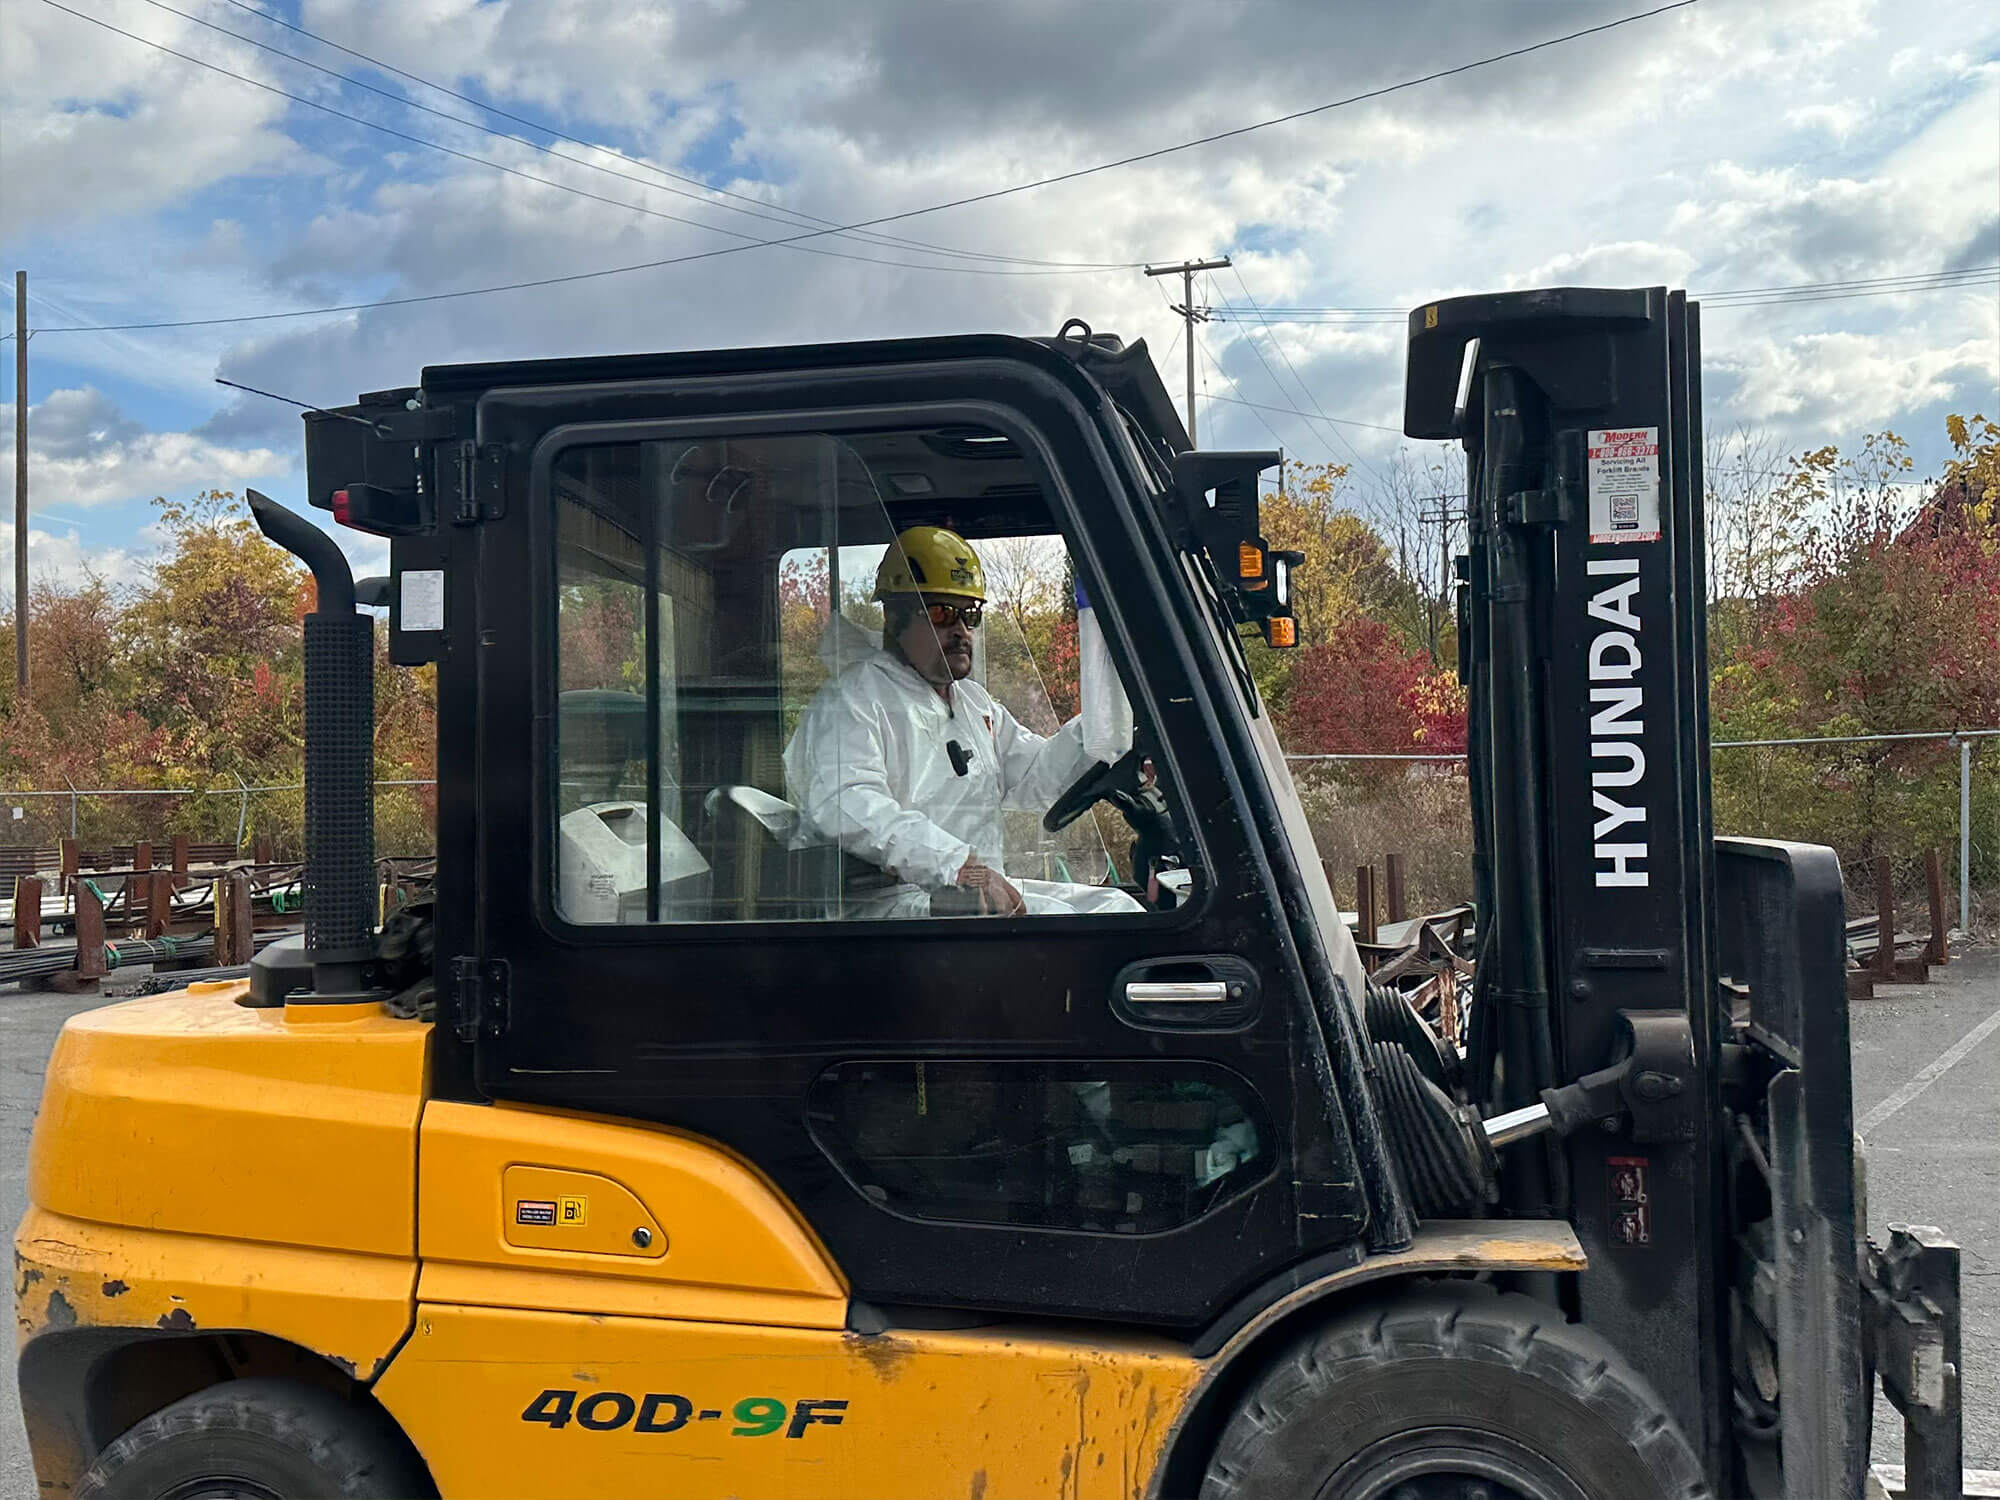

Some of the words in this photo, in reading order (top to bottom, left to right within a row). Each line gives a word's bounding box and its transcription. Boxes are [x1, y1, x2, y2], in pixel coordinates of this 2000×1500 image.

[1603, 431, 1648, 443] MODERN
[1601, 458, 1634, 467] Servicing
[1597, 466, 1623, 475] Forklift
[1624, 465, 1650, 473] Brands
[1586, 558, 1649, 887] HYUNDAI
[520, 1389, 849, 1439] 40D-9F
